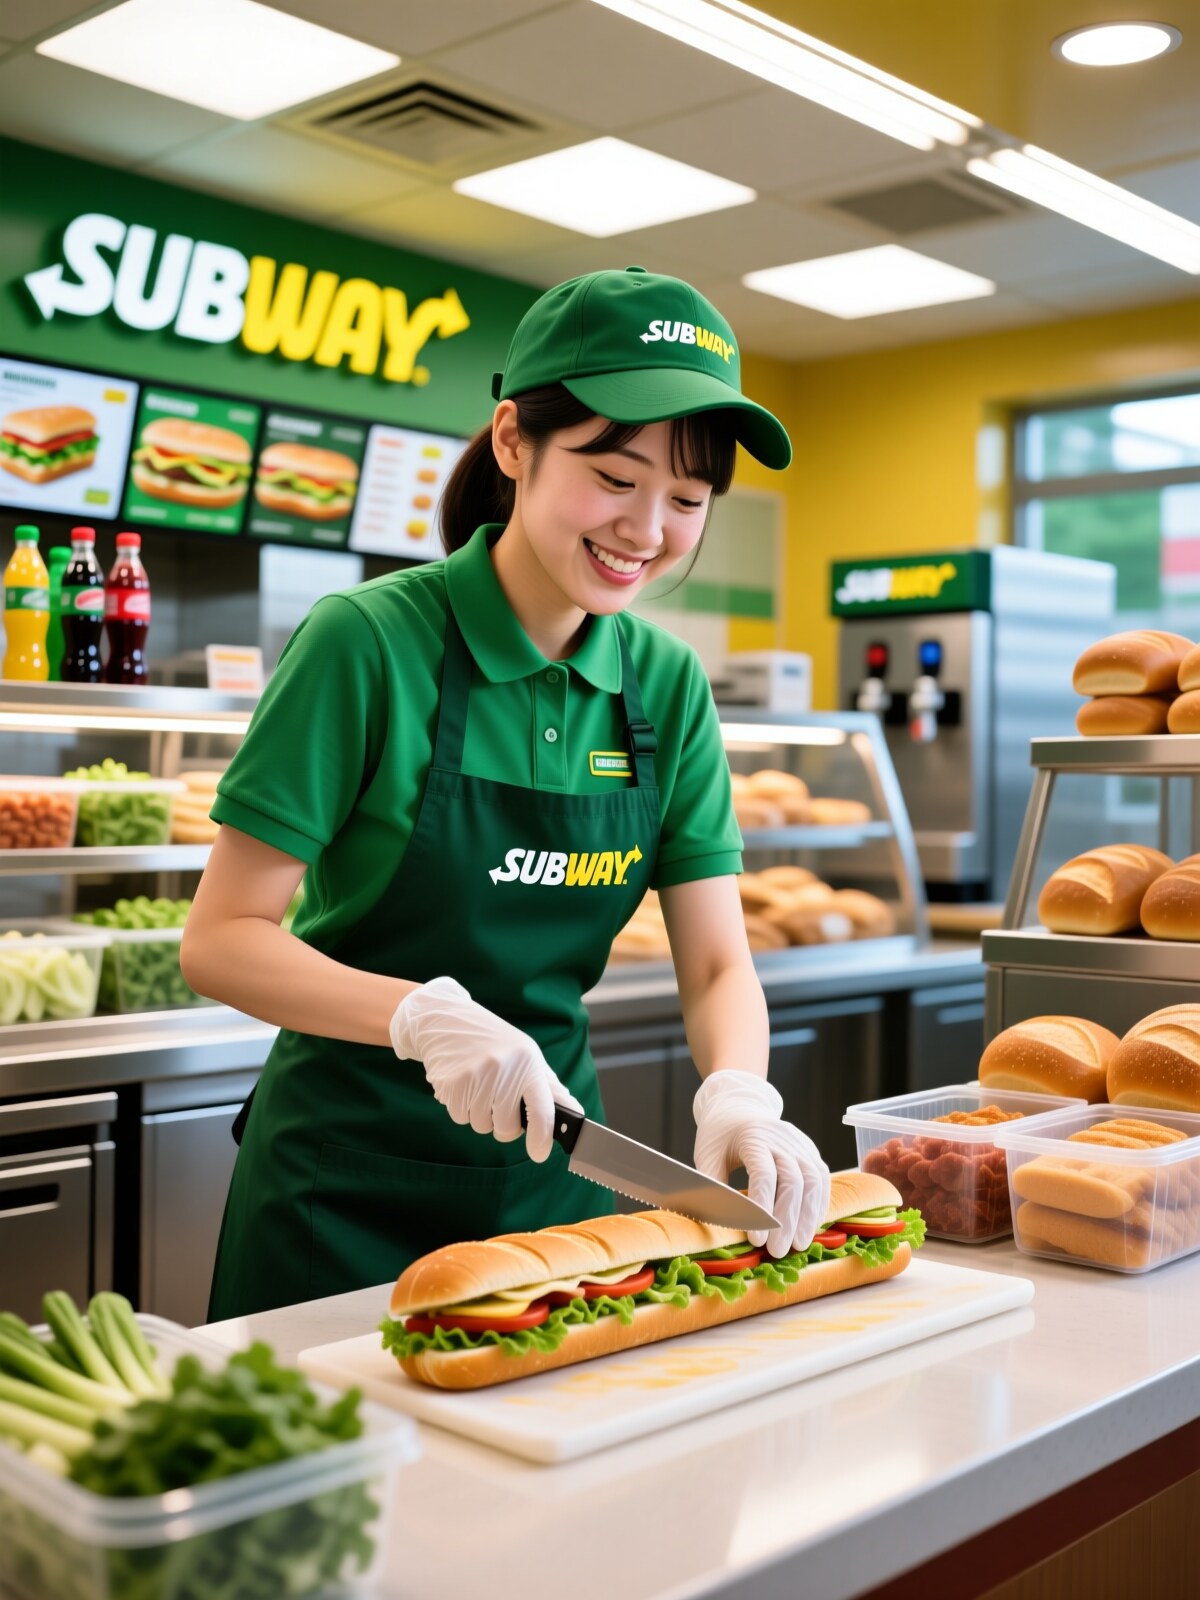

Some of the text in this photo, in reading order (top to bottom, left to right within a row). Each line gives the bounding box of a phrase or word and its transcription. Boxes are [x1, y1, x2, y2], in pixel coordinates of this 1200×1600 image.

[24, 213, 470, 383] SUBWAY
[639, 320, 735, 364] SUBWAY
[488, 844, 643, 887] SUBWAY
